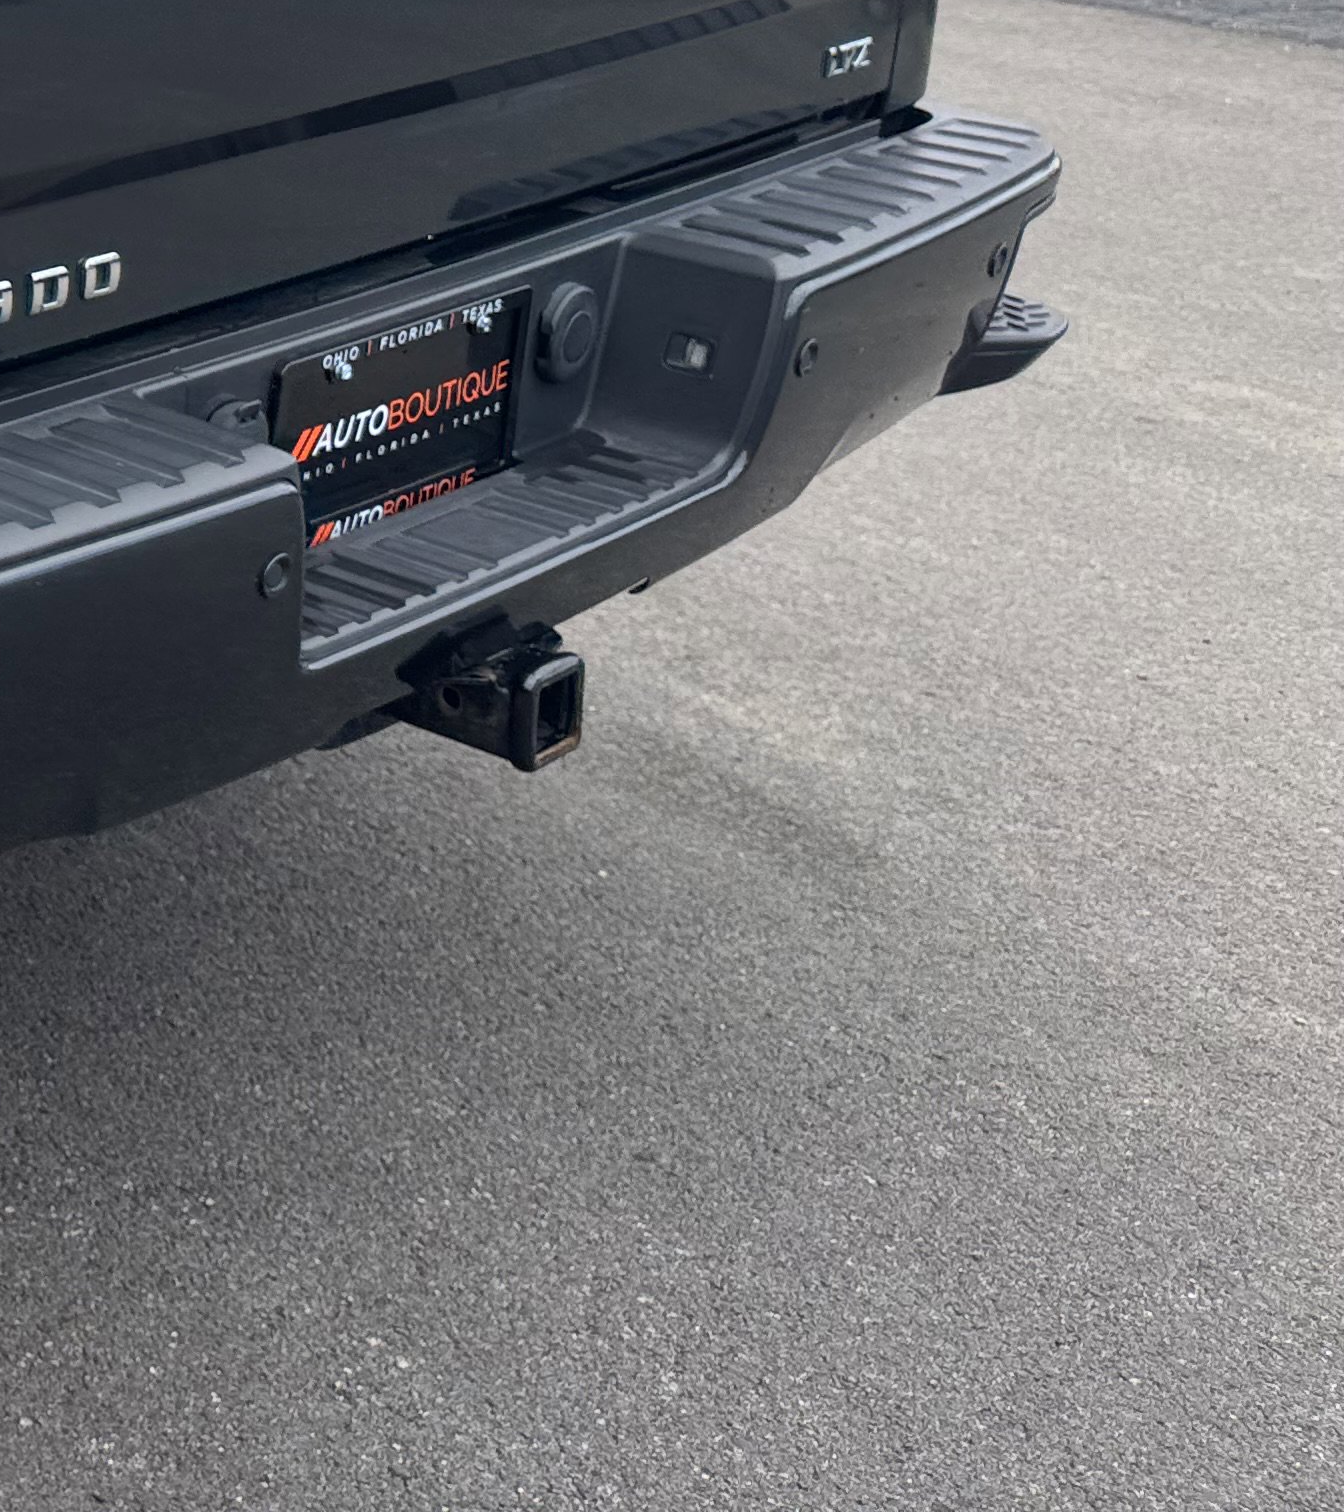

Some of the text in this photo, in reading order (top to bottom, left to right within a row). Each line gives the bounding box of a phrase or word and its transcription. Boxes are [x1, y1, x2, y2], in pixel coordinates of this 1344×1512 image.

[823, 35, 874, 78] LTZ
[322, 298, 504, 371] OHIO FLORIDA TEXAS
[303, 401, 501, 483] HIO FLORIDA TEXAS
